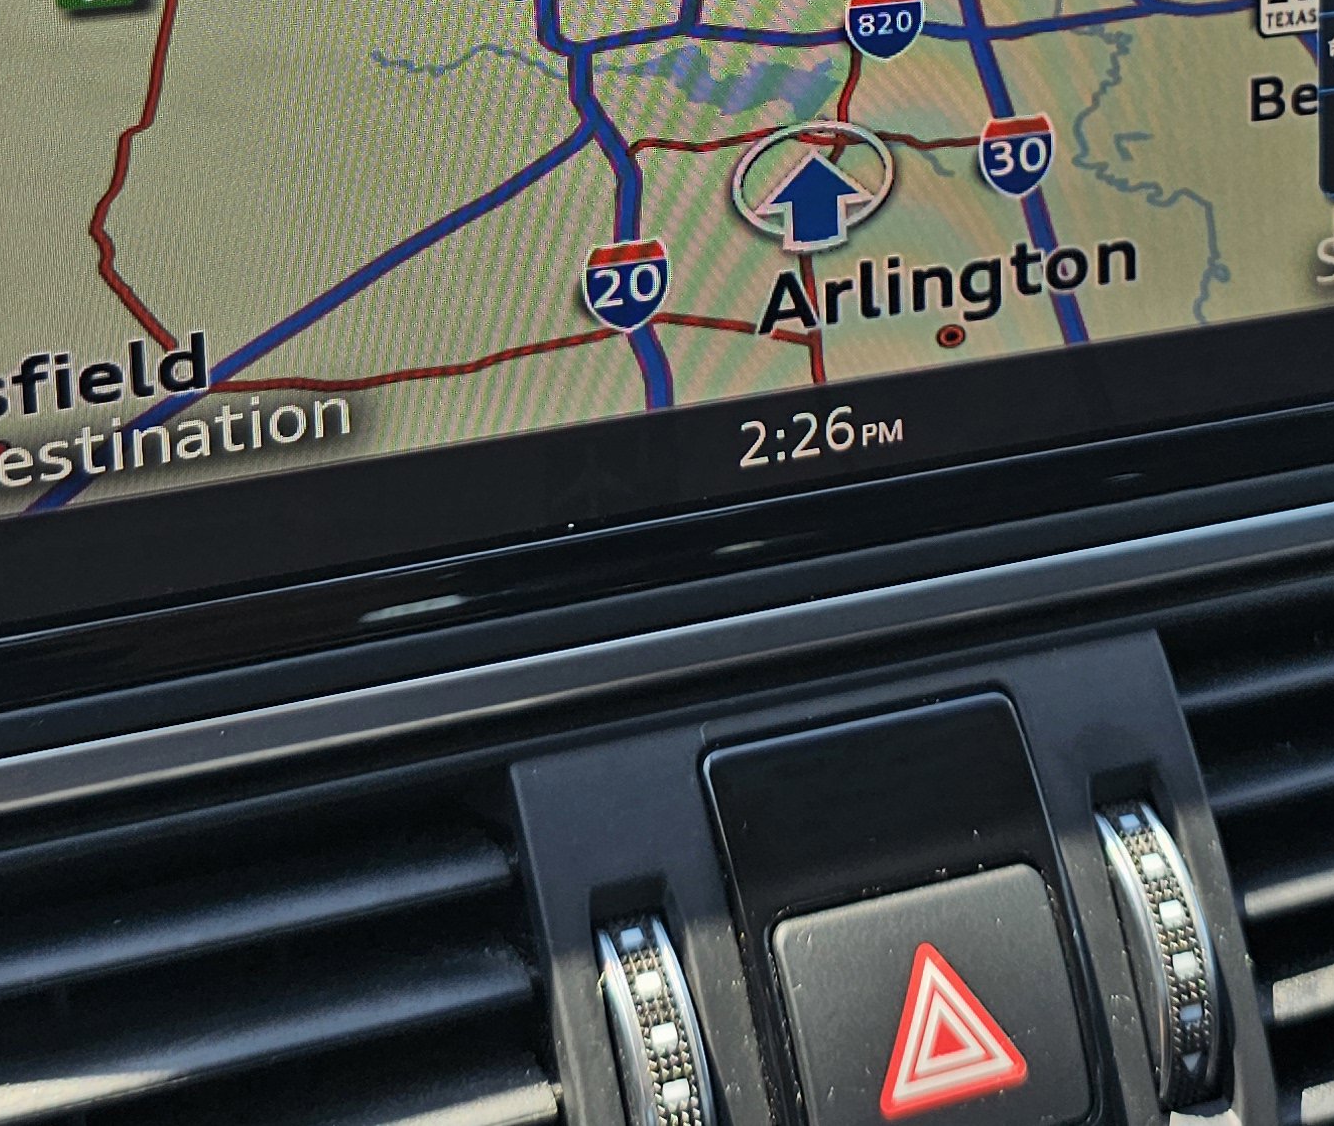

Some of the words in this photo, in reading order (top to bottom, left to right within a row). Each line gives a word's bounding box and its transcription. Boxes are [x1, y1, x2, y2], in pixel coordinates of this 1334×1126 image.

[858, 10, 912, 36] 820
[1265, 9, 1317, 26] TEXAS
[990, 137, 1047, 176] 30
[594, 263, 659, 309] 20
[760, 237, 1137, 335] Arlington
[740, 406, 854, 468] 2:26
[863, 419, 902, 447] PM
